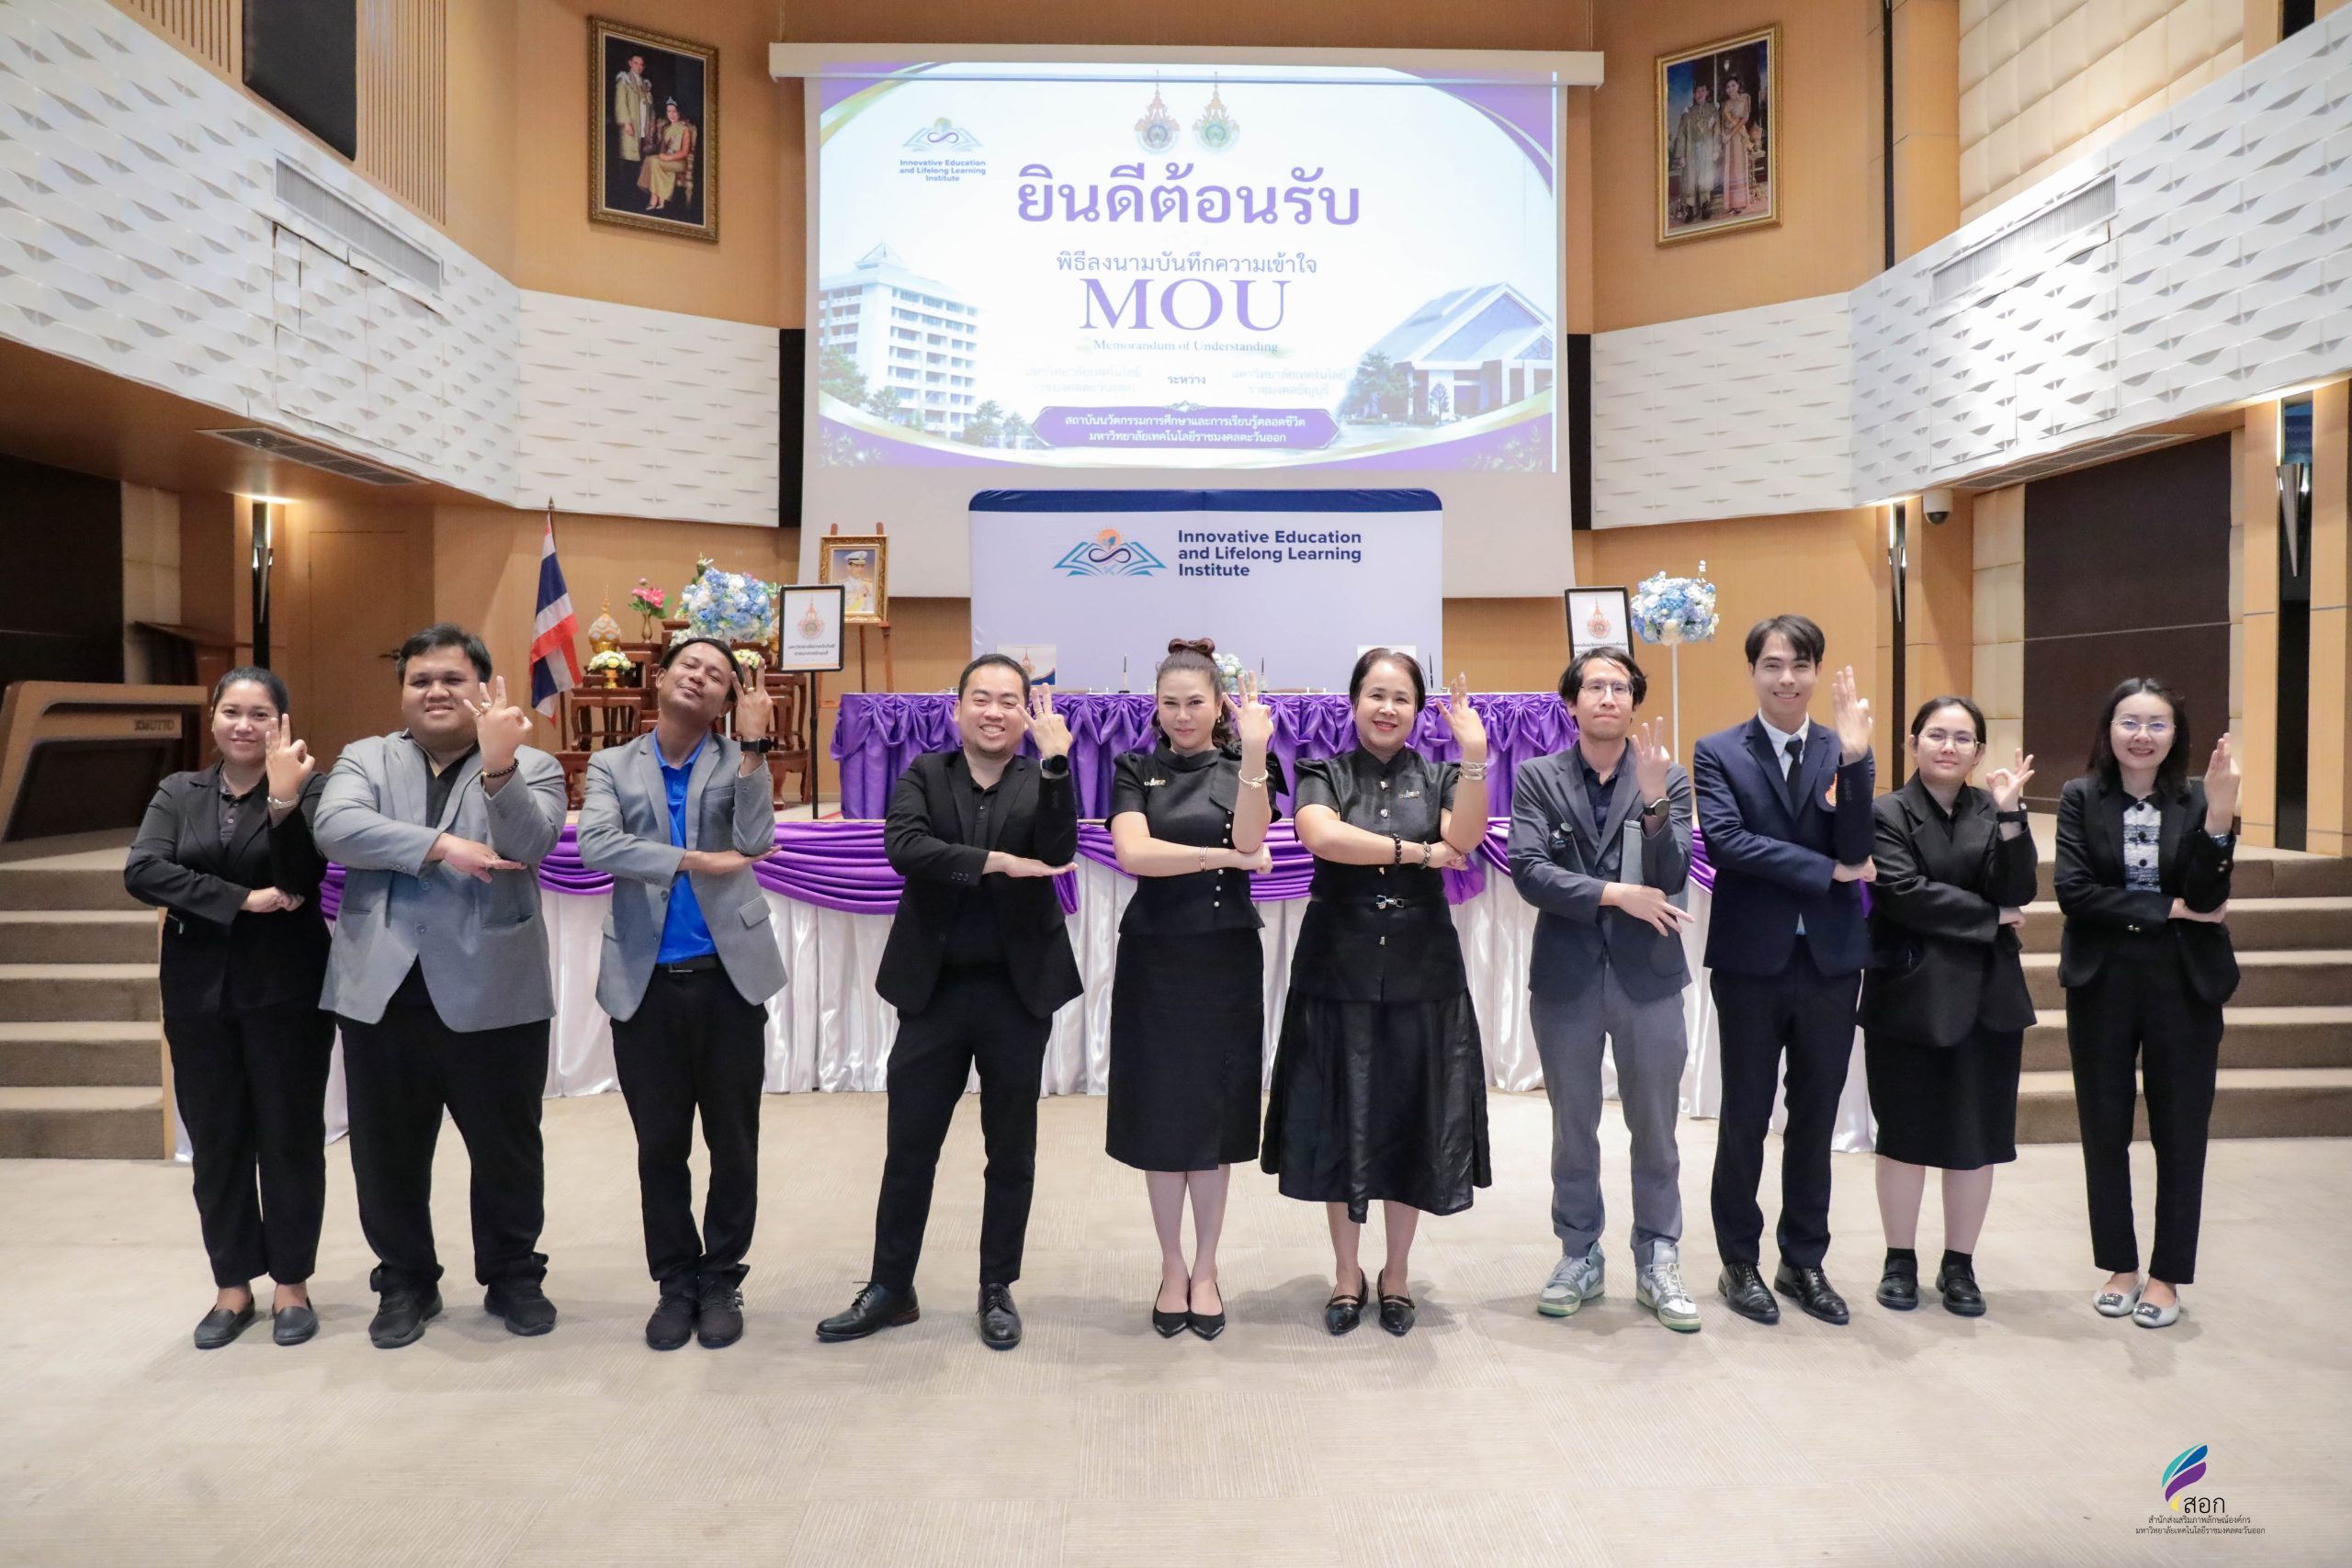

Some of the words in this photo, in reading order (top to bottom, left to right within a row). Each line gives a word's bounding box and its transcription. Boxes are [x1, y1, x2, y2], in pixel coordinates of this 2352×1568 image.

[916, 167, 949, 175] Lifelong
[951, 167, 986, 175] Learning
[1018, 162, 1360, 226] ยินดีต้อนรับ
[1057, 250, 1317, 275] พิธีลงนามบันทึกความเข้าใจ
[1079, 278, 1292, 332] MOU
[1094, 339, 1175, 352] Memorandum
[1178, 339, 1192, 352] of
[1193, 341, 1279, 355] Understanding
[1179, 530, 1269, 543] Innovative
[1275, 530, 1362, 544] Education
[1179, 547, 1210, 559] and
[1216, 547, 1283, 563] Lifelong
[1288, 547, 1362, 563] Learning
[1179, 563, 1250, 576] Institute
